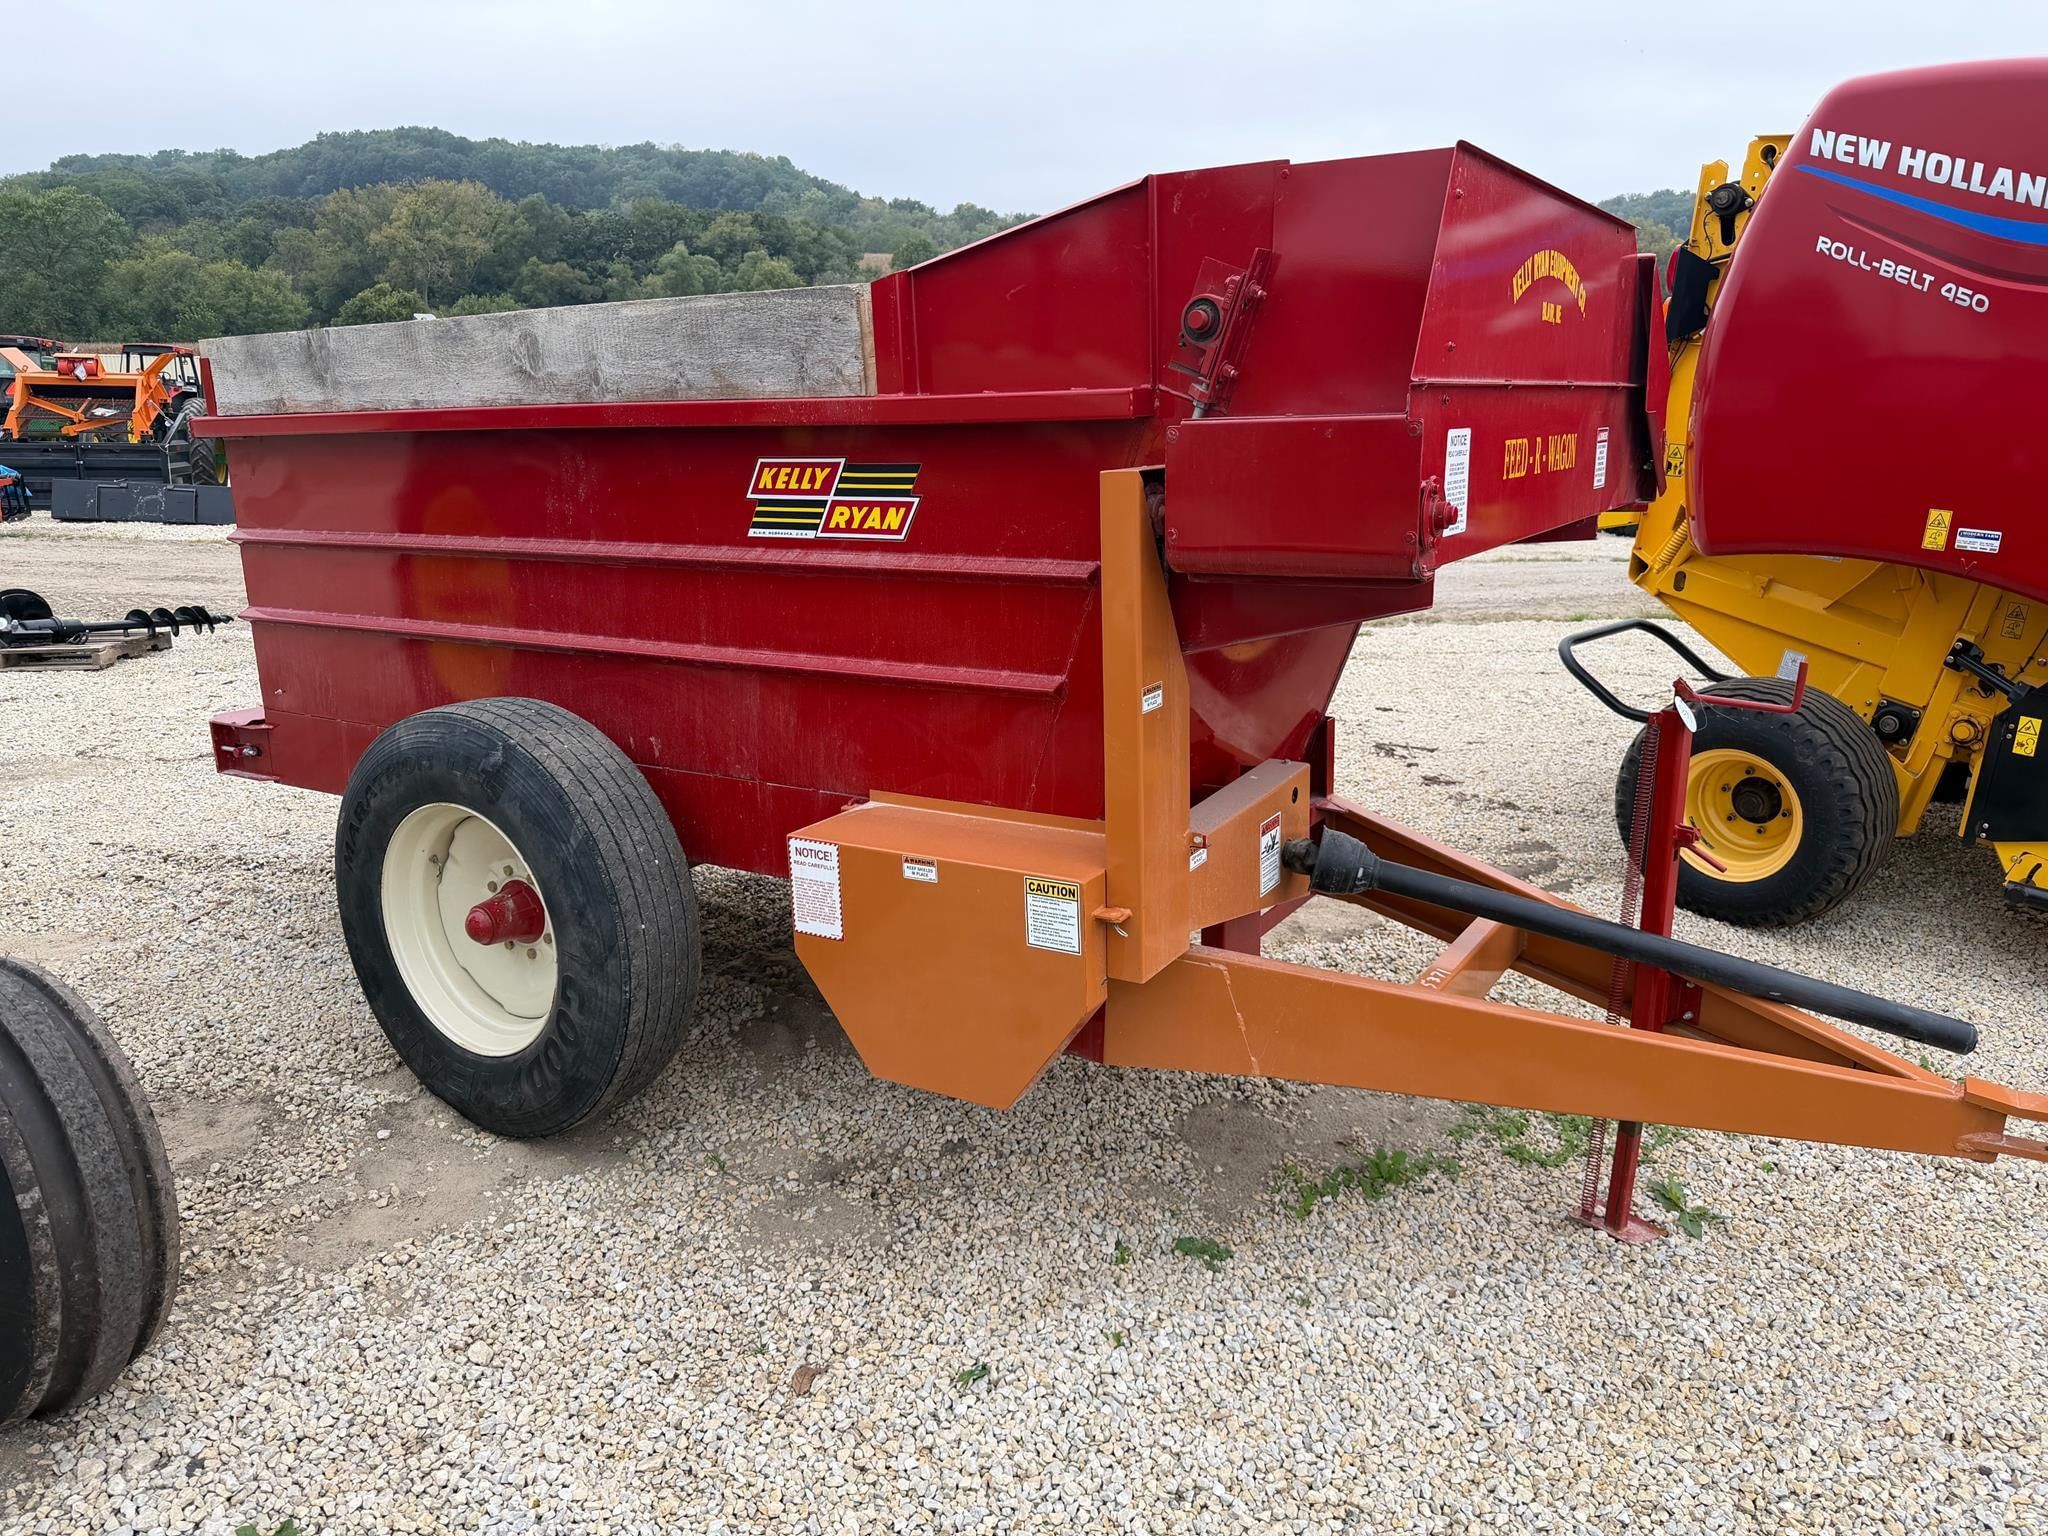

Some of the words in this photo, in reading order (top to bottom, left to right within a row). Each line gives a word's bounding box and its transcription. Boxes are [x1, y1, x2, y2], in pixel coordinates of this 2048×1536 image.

[1810, 128, 1891, 170] NEW
[1897, 145, 2048, 210] HOLLAN
[1815, 235, 1935, 292] ROLL-BELT
[1940, 282, 1990, 313] 450
[757, 467, 832, 490] KELLY
[829, 506, 906, 530] RYAN
[793, 859, 807, 867] READ
[807, 861, 836, 871] CAREFULLY
[794, 846, 833, 862] NOTICE!
[1028, 881, 1076, 898] CAUTION
